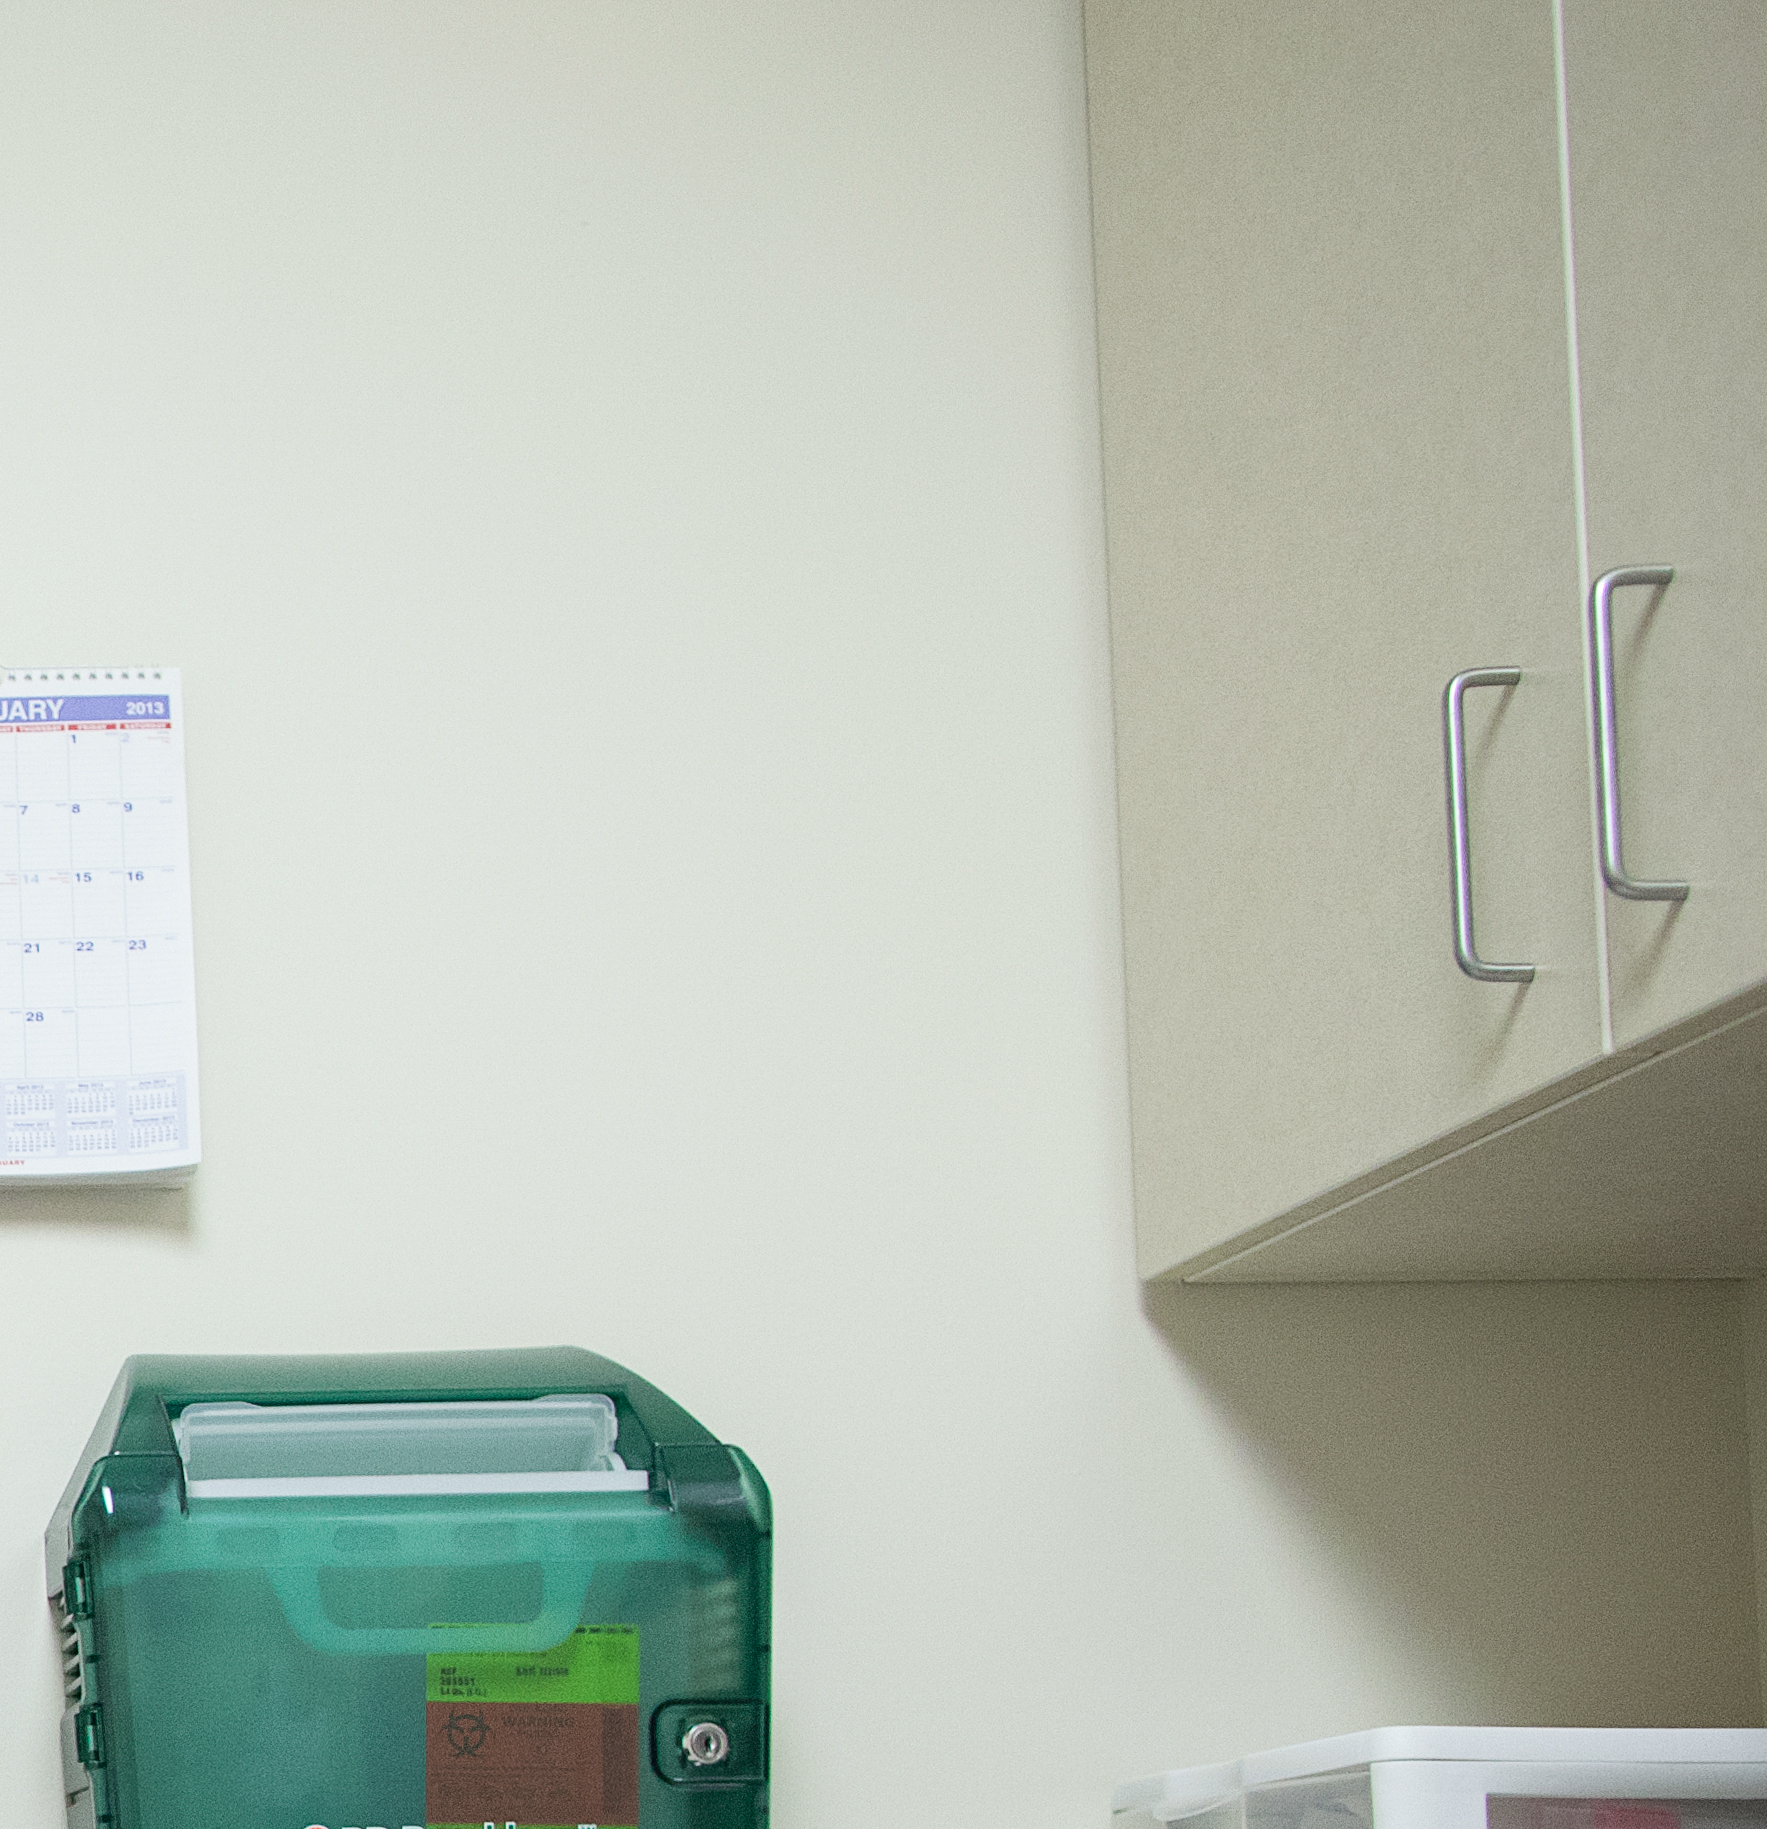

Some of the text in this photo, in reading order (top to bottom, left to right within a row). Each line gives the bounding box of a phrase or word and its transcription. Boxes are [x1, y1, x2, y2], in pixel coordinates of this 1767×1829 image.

[125, 701, 165, 715] 2013
[19, 804, 28, 815] 7
[71, 803, 80, 814] 8
[123, 801, 133, 812] 9
[75, 871, 92, 883] 15
[127, 870, 144, 881] 16
[24, 942, 41, 954] 21
[76, 941, 95, 952] 22
[129, 939, 147, 951] 23
[26, 1011, 44, 1023] 28
